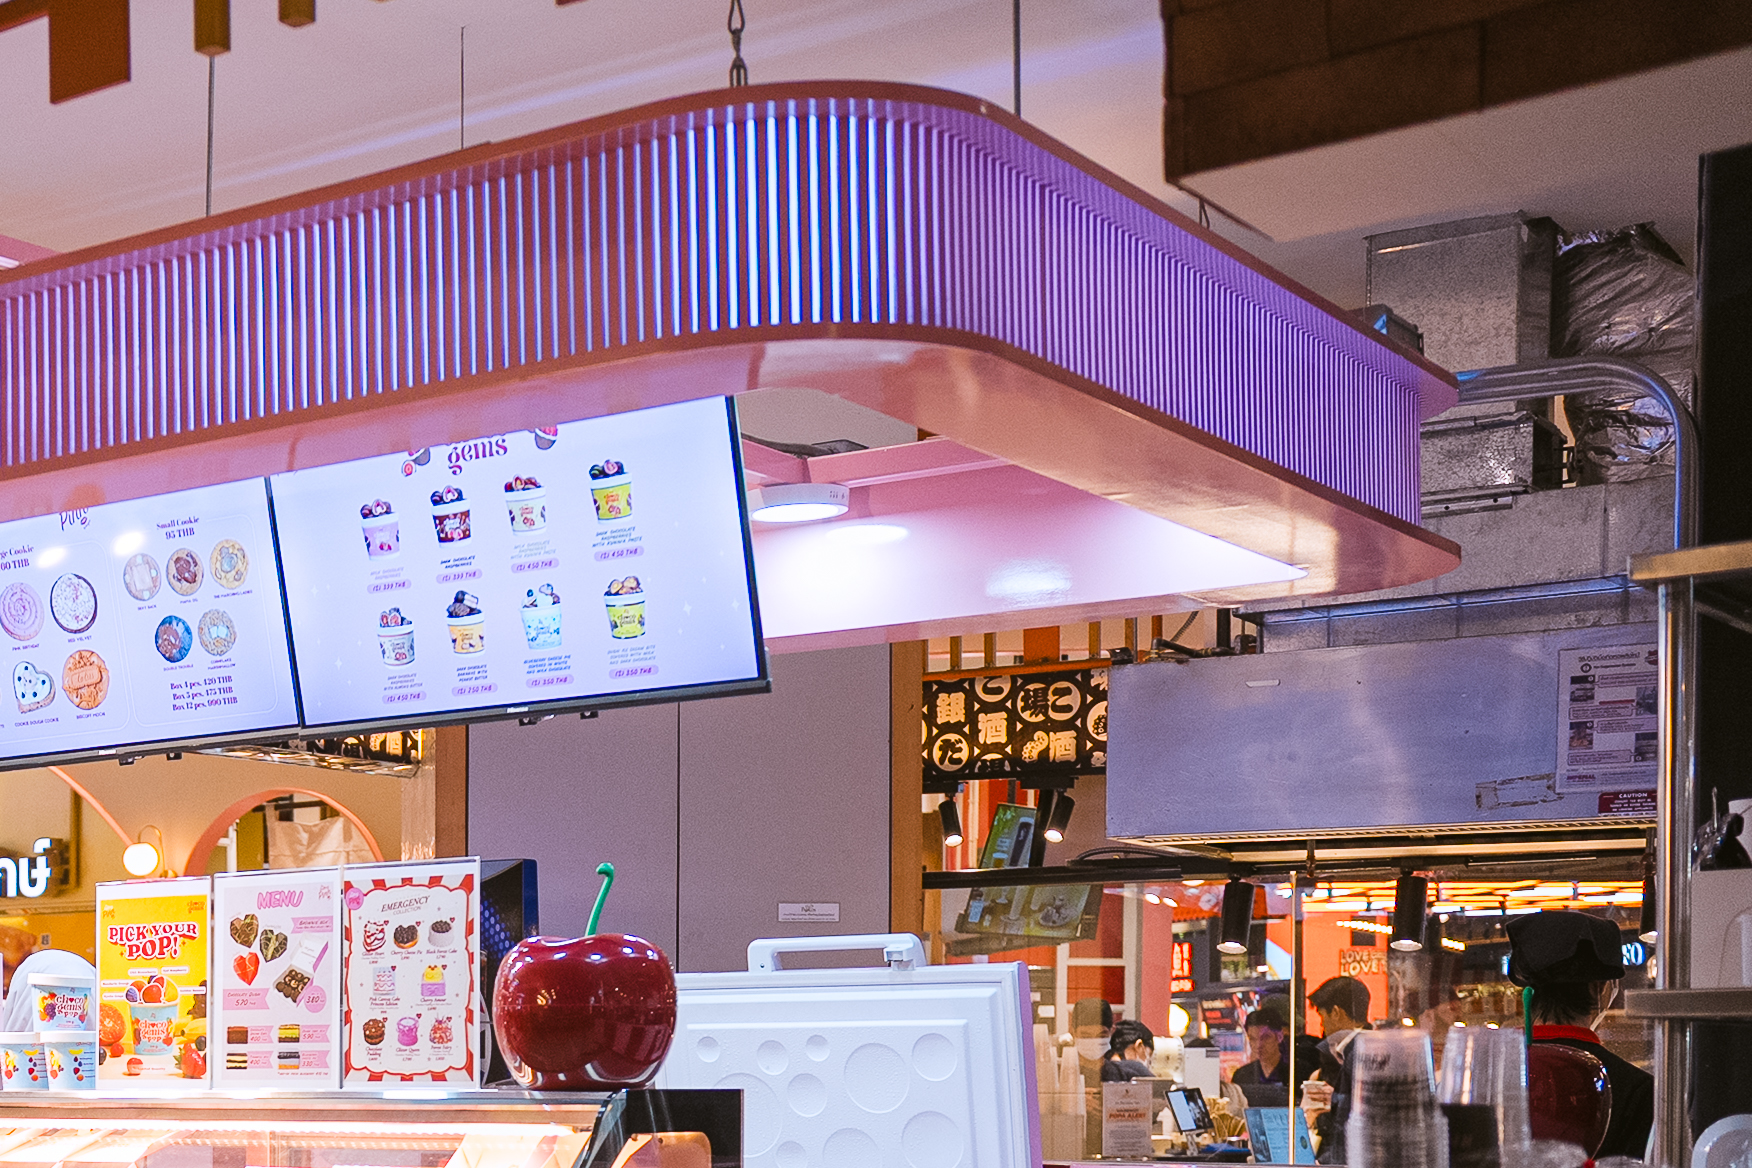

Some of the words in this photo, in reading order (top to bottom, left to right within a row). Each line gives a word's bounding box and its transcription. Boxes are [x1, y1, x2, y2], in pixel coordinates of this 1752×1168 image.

[447, 438, 508, 475] gems
[176, 515, 199, 527] Cookie
[9, 544, 34, 556] Cookie
[978, 711, 1008, 744] 酒
[1049, 730, 1077, 763] 酒
[257, 889, 304, 910] MENU
[380, 895, 431, 913] EMERGENCY
[109, 924, 148, 943] PICK
[151, 922, 197, 937] YOUR
[127, 935, 178, 959] POP!
[1340, 961, 1379, 976] LOVE
